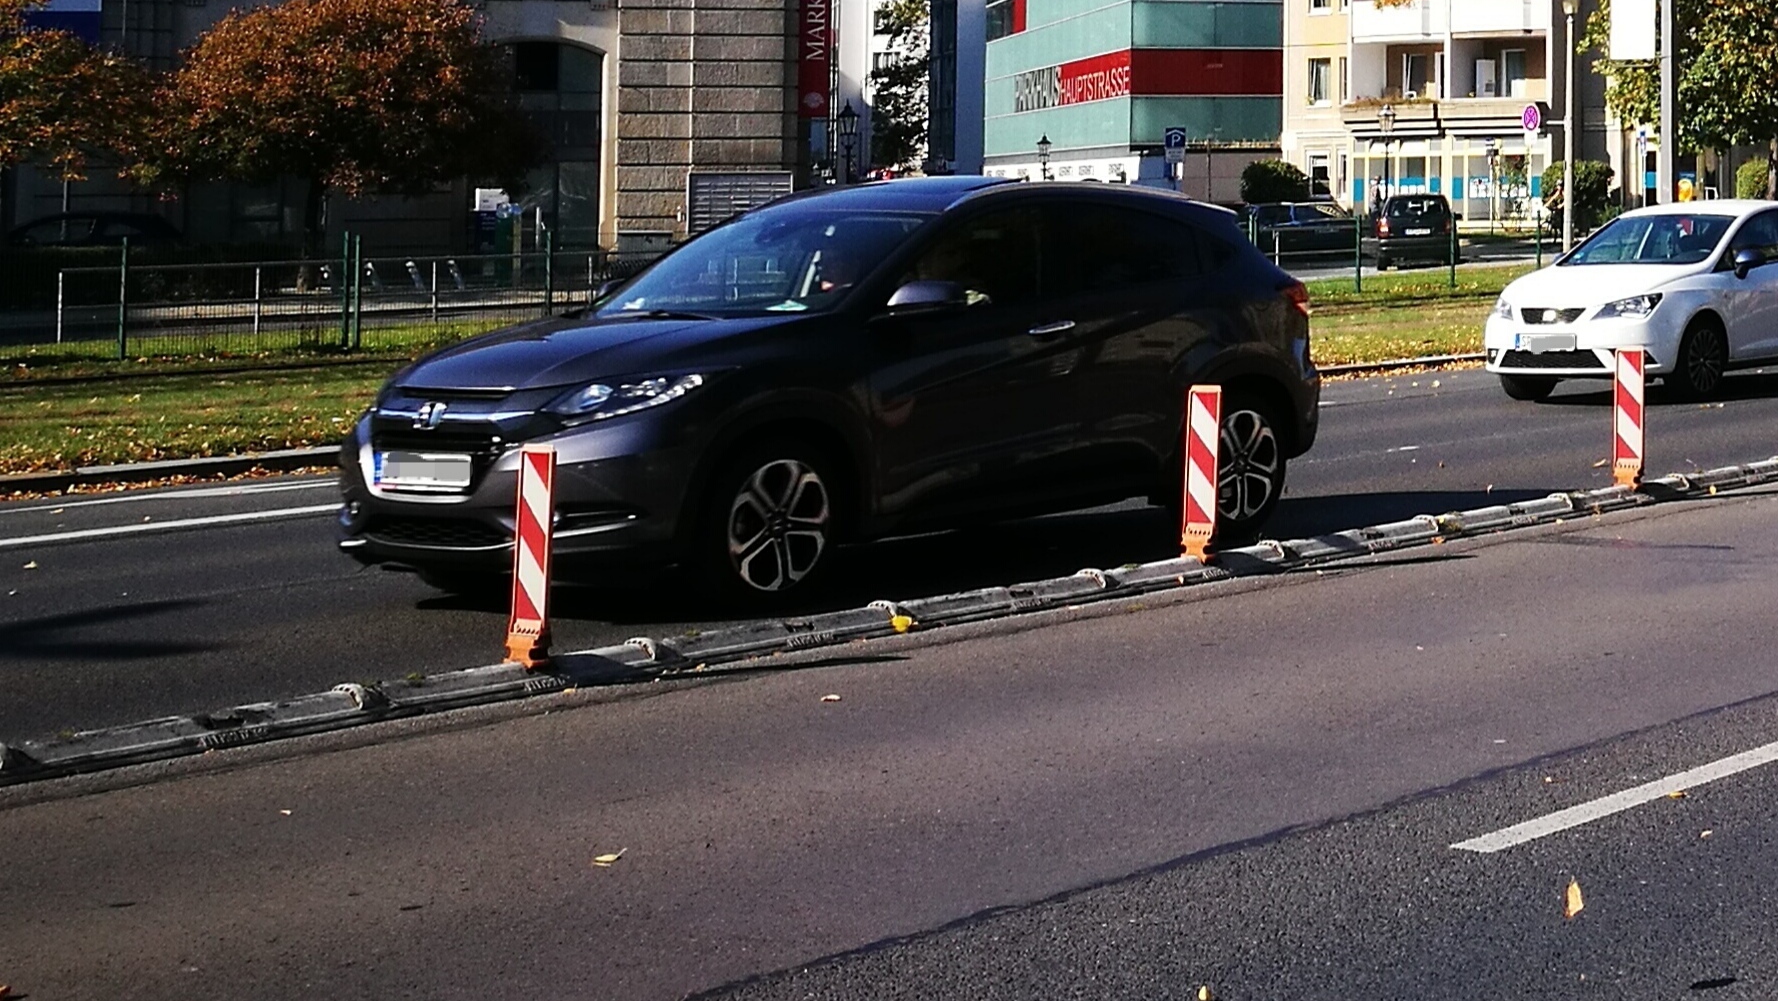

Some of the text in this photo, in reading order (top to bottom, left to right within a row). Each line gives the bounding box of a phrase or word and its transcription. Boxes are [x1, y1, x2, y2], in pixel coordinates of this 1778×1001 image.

[1014, 65, 1130, 113] PARKHAUS HAUPTSTRASSE
[1171, 134, 1181, 147] P
